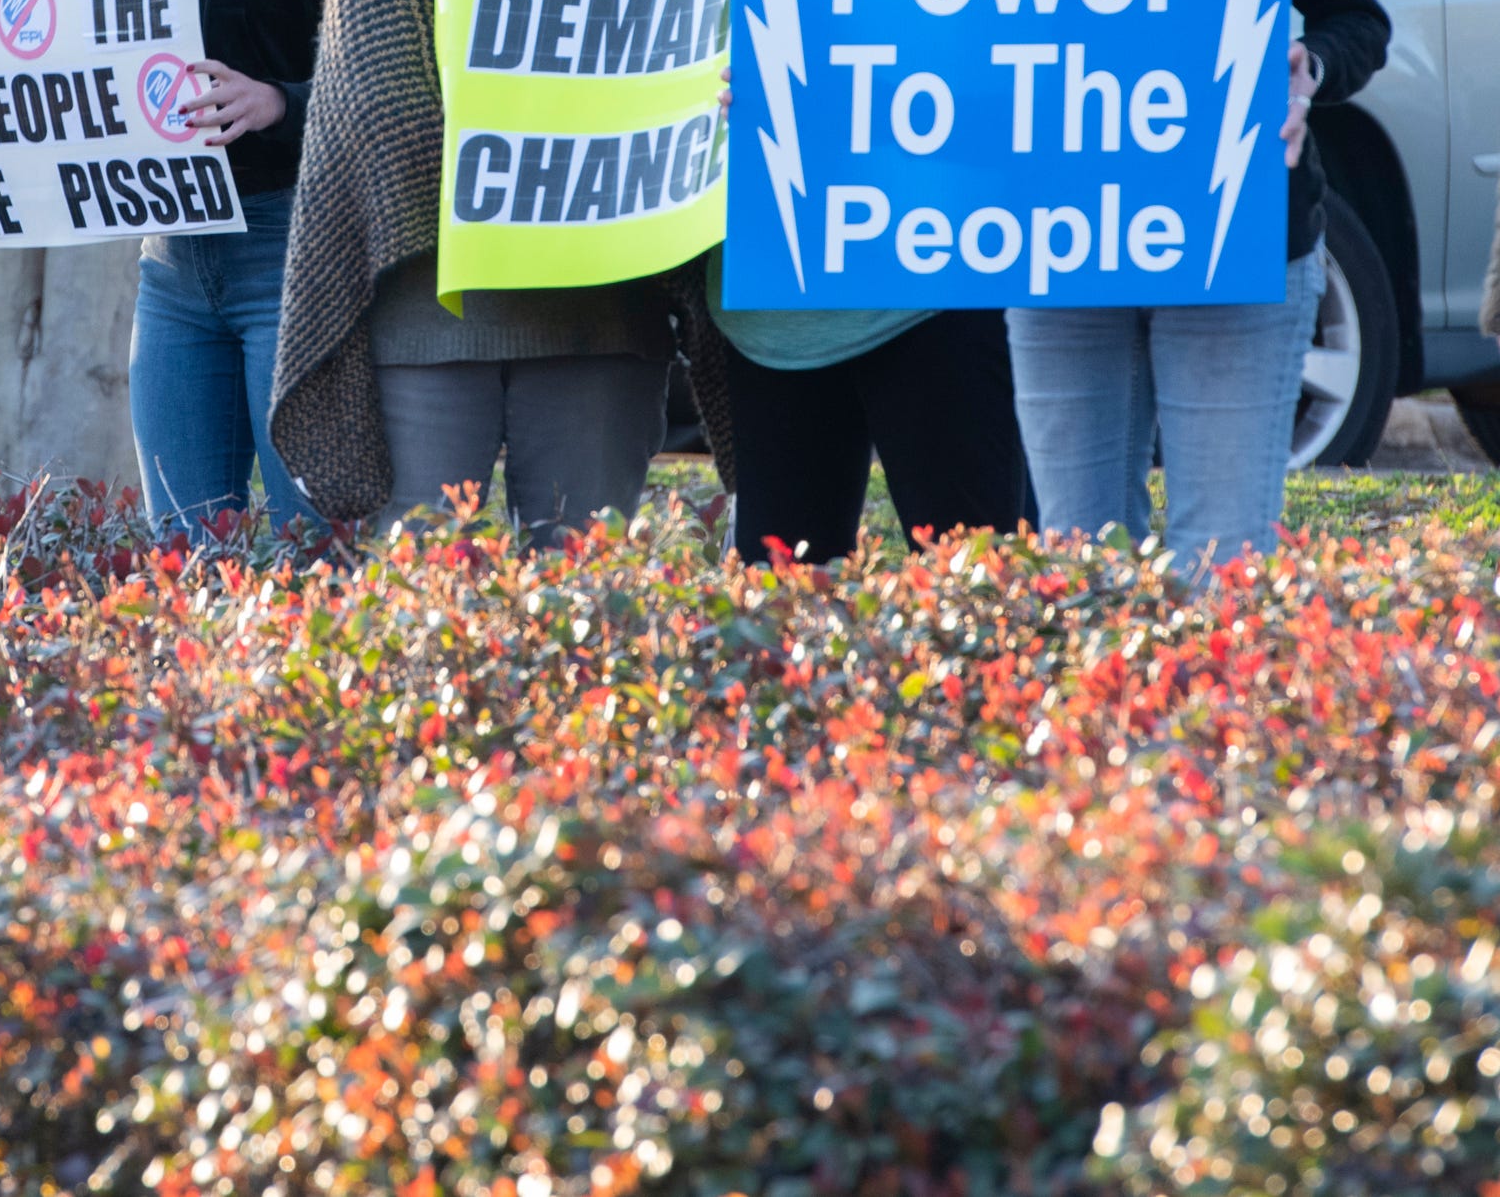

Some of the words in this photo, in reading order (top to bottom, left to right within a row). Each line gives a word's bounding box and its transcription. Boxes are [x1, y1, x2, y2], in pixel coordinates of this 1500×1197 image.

[830, 44, 955, 155] To
[990, 43, 1188, 153] The
[57, 155, 234, 229] PISSED
[824, 183, 1186, 295] People
